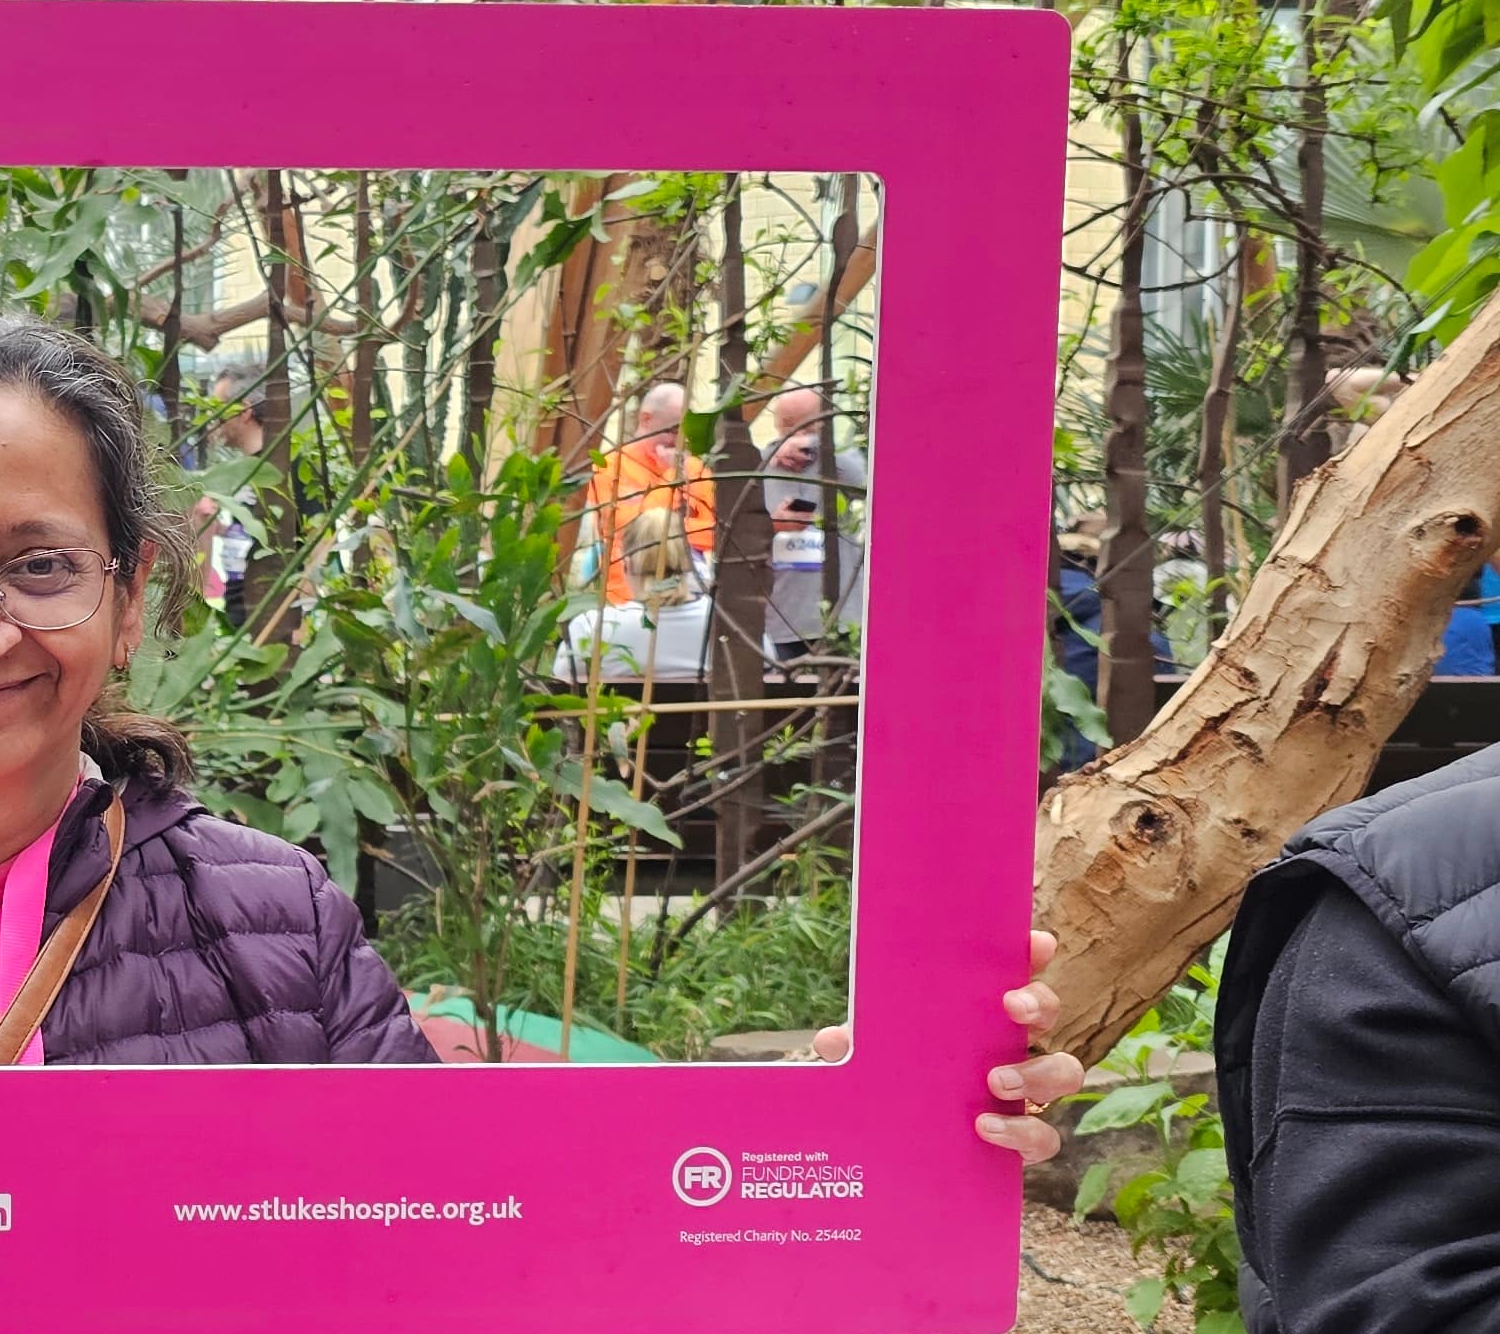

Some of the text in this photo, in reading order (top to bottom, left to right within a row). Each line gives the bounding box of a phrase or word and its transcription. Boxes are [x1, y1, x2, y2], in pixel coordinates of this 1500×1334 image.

[741, 1151, 829, 1164] Registered with
[741, 1165, 864, 1181] FUNDRAISING
[741, 1182, 864, 1199] REGULATOR
[173, 1195, 523, 1227] www.stlukeshospice.org.uk
[679, 1228, 862, 1246] Registered Charity No. 254402
